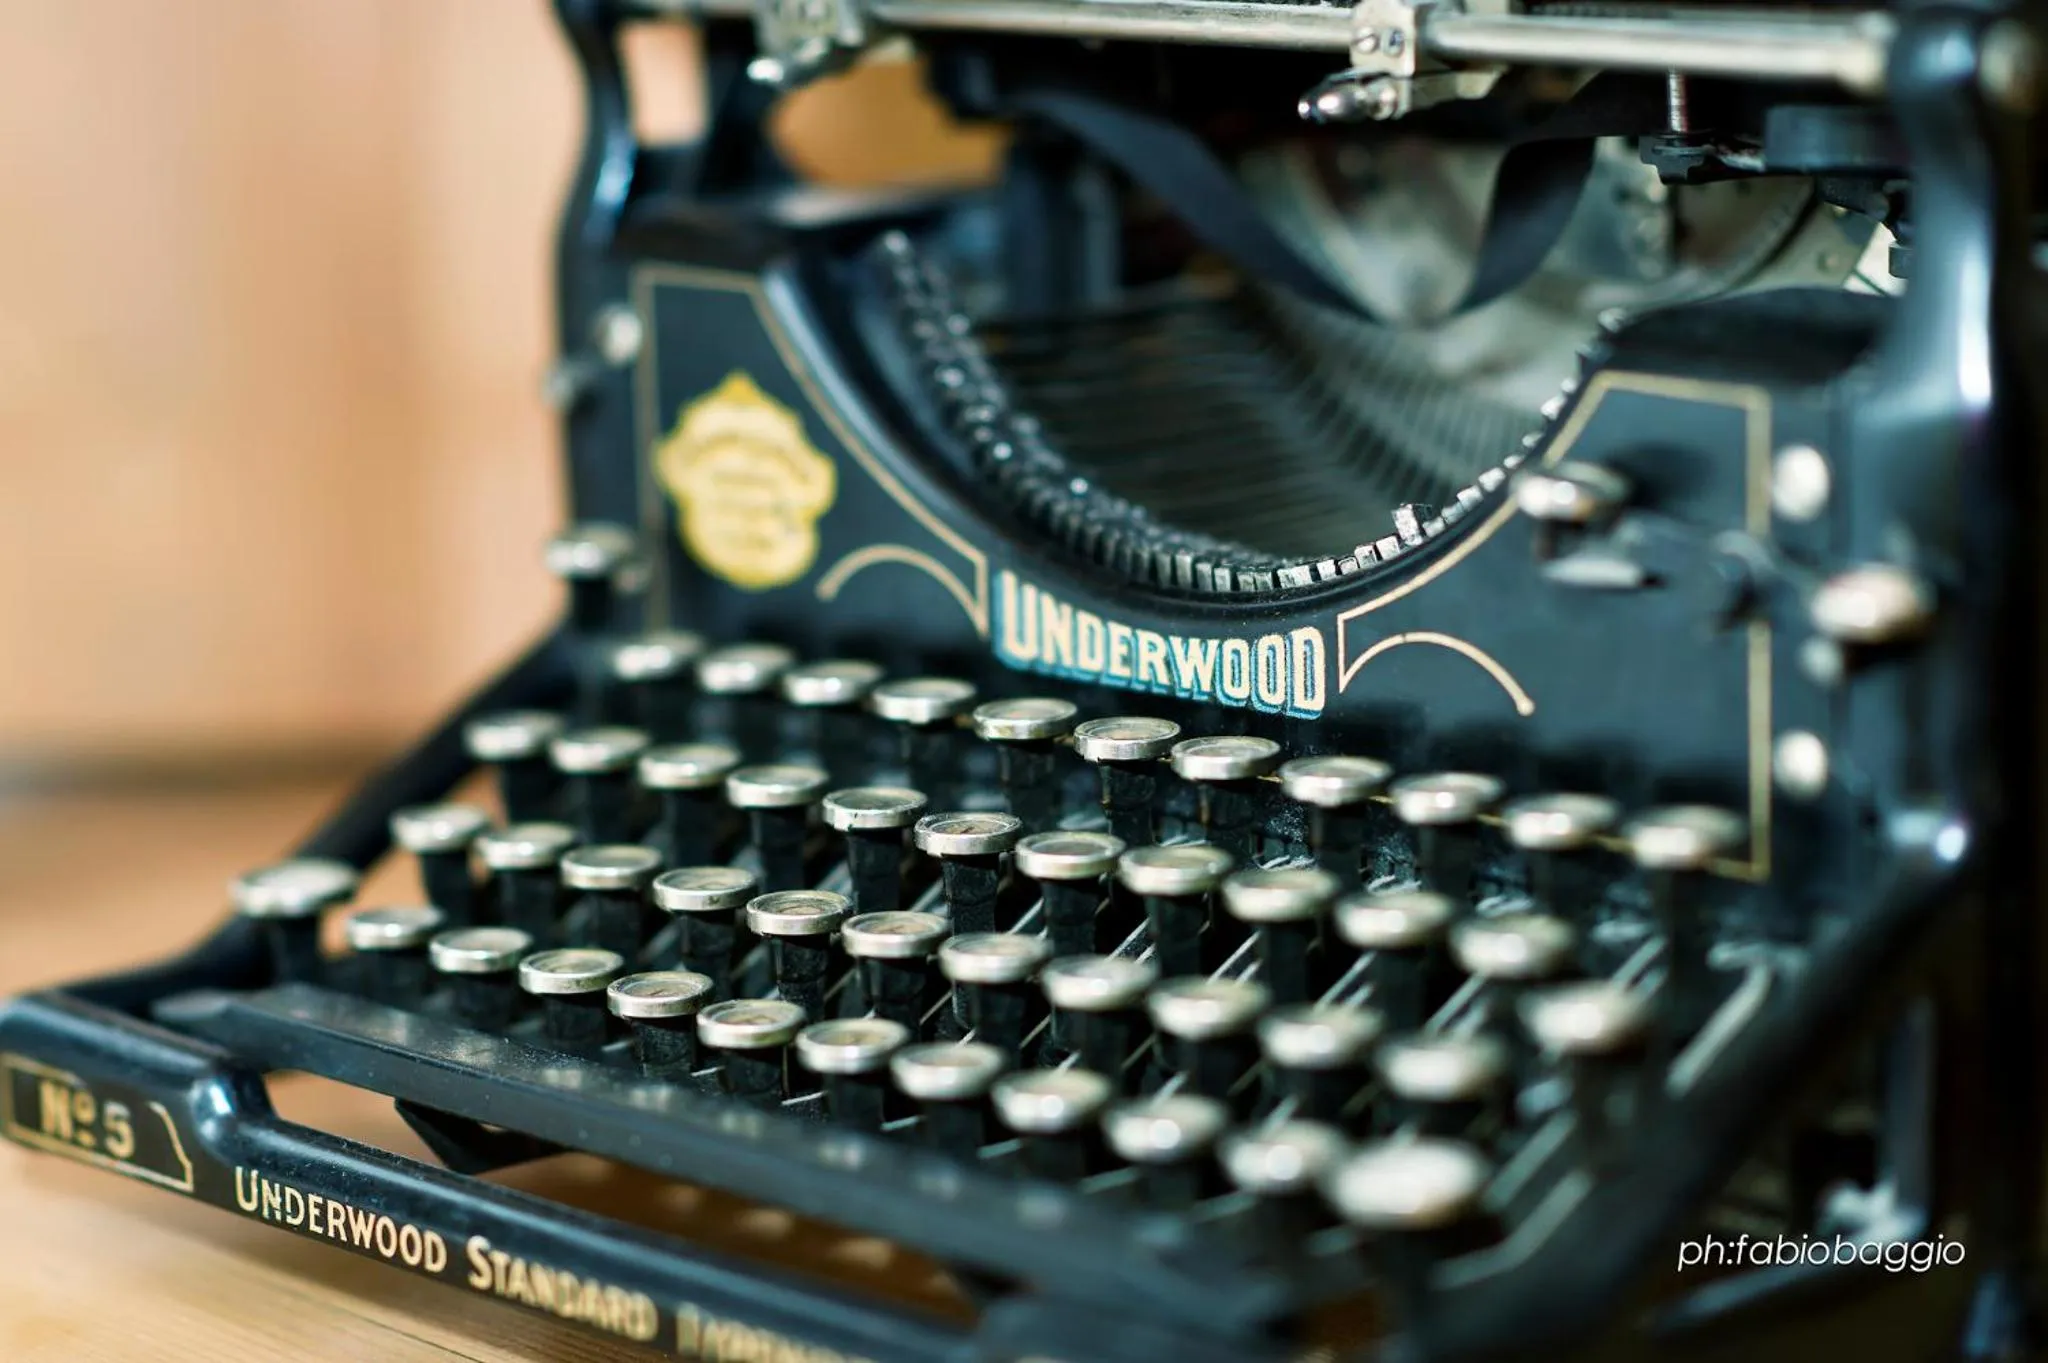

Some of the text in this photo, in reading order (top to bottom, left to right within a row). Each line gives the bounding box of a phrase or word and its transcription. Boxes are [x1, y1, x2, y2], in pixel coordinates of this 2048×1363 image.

[993, 569, 1326, 720] UNDERWOOD
[103, 1101, 135, 1158] 5
[235, 1166, 448, 1273] UNDERWOOD
[466, 1235, 659, 1341] STANDARD
